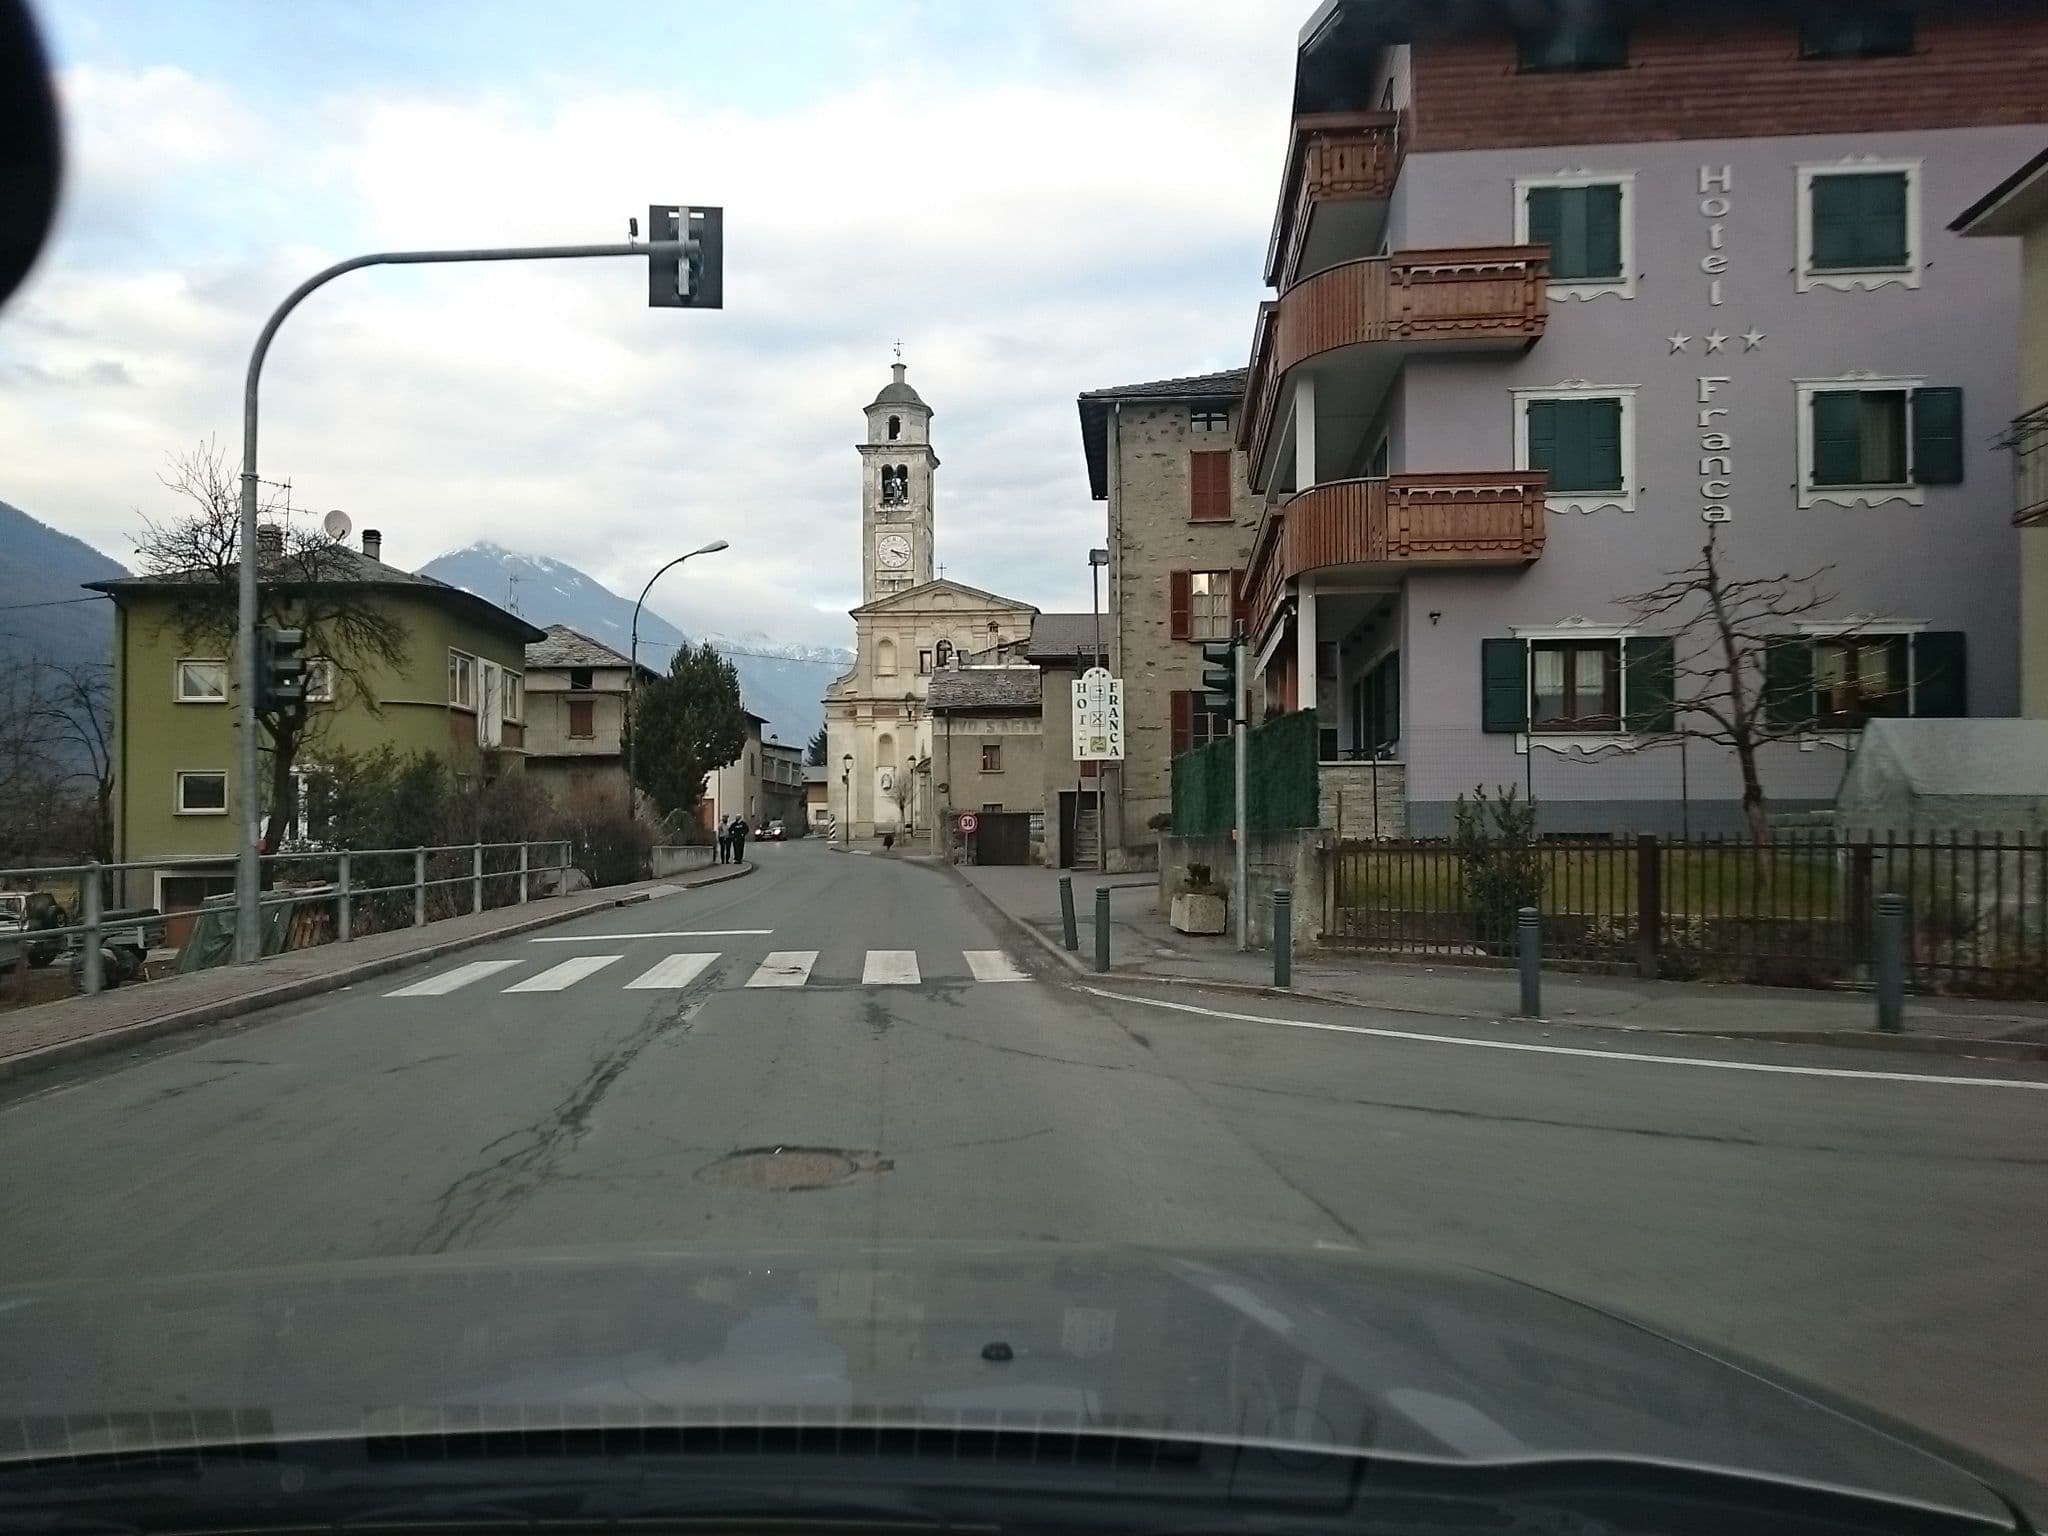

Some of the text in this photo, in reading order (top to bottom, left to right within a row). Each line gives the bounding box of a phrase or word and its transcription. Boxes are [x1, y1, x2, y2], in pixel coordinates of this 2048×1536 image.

[1698, 164, 1732, 523] Hotel Franca
[1108, 681, 1120, 756] FRANCA
